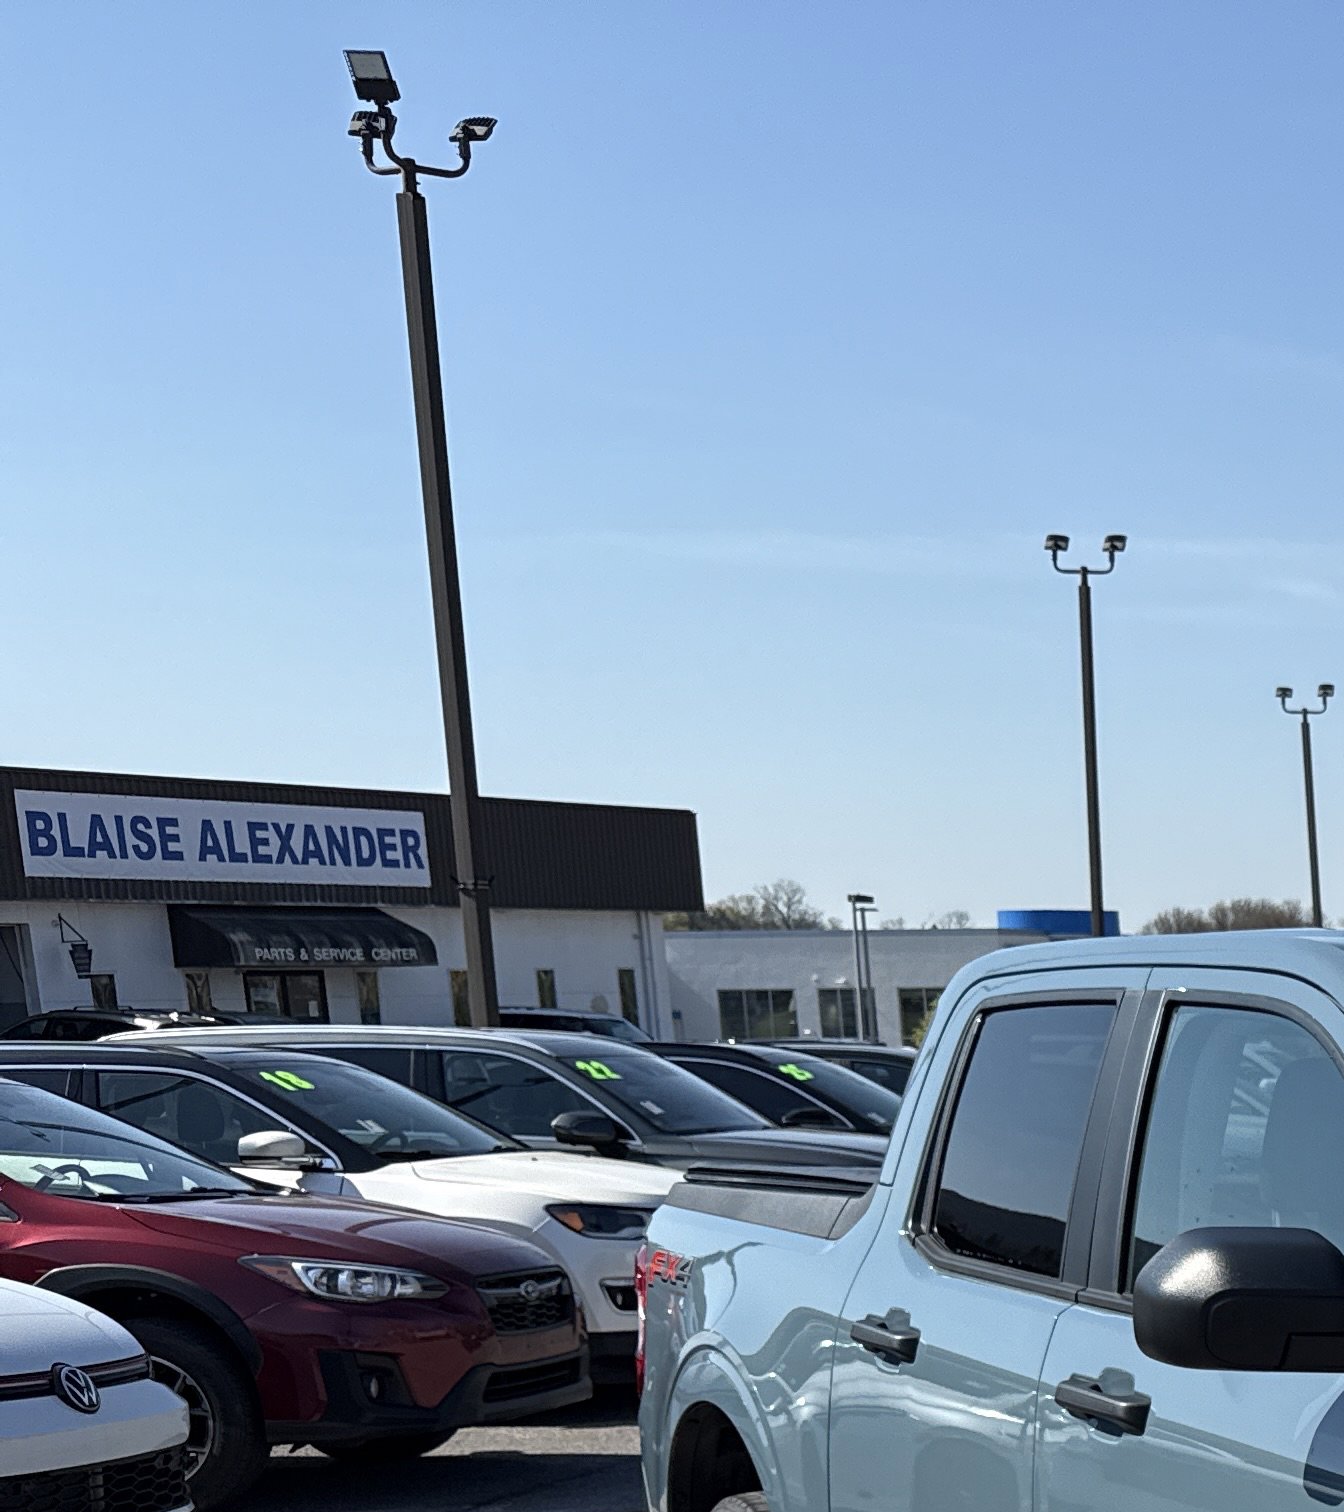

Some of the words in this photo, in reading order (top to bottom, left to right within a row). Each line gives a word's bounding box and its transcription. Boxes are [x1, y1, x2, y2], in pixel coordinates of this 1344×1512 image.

[24, 810, 184, 861] BLAISE
[198, 818, 425, 869] ALEXANDER
[255, 947, 294, 961] PARTS
[300, 948, 309, 961] &
[313, 948, 365, 961] SERVICE
[372, 948, 418, 961] CENTER
[258, 1069, 316, 1092] 18
[574, 1059, 623, 1082] 22
[648, 1250, 693, 1287] FX4
